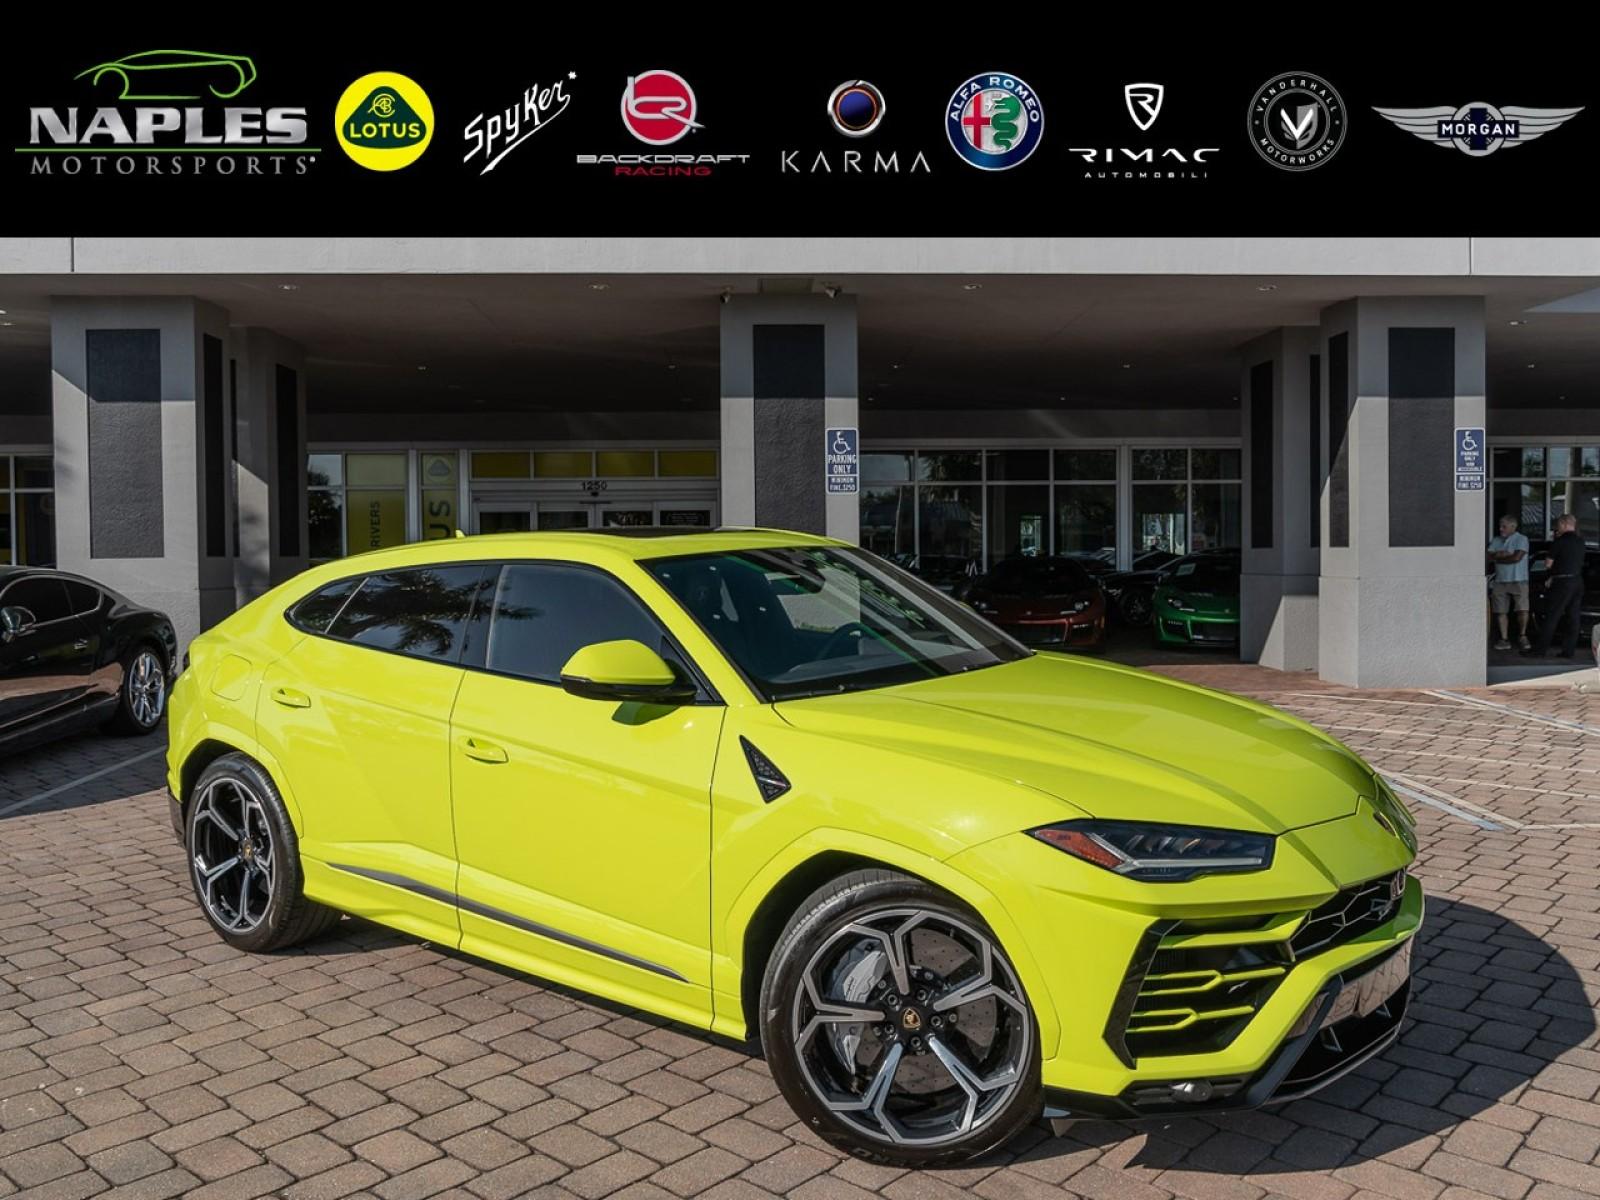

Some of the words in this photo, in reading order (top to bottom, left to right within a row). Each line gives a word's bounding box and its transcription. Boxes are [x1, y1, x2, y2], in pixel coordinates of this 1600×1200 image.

[827, 454, 857, 464] PARKING
[833, 464, 851, 474] ONLY
[582, 480, 608, 491] 1250
[370, 501, 381, 548] RIVERS
[427, 500, 452, 540] US
